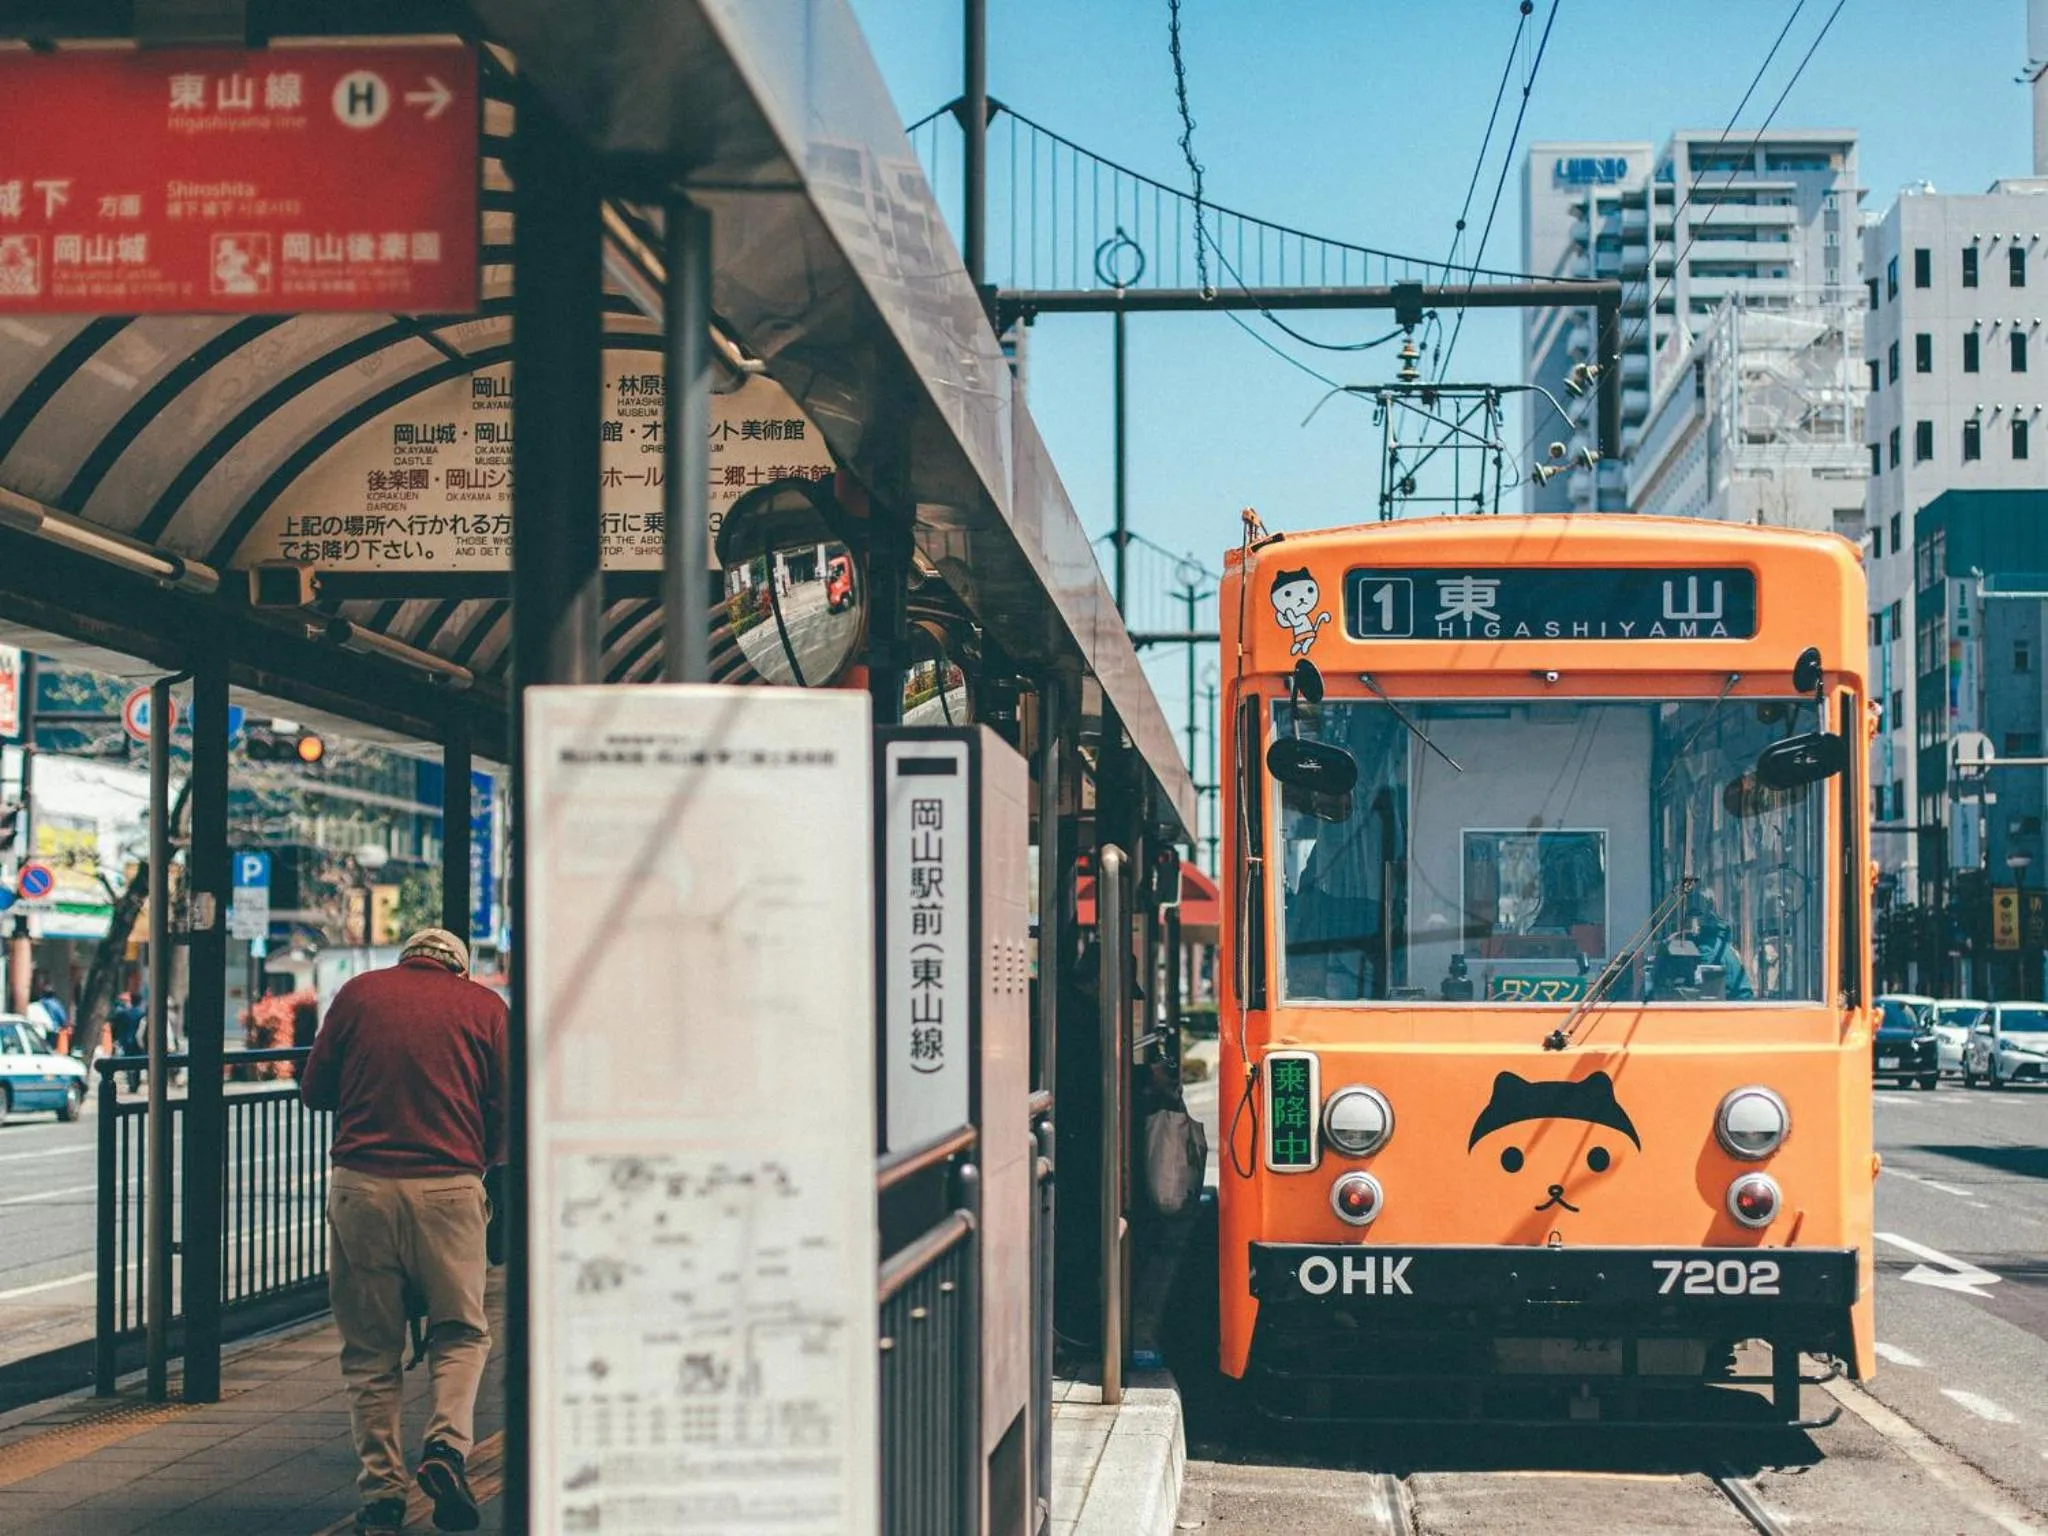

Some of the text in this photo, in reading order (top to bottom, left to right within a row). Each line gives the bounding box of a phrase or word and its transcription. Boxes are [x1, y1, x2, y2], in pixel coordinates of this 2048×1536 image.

[169, 73, 303, 111] 東山線
[349, 81, 374, 115] H
[167, 181, 256, 197] Shiroshita
[99, 194, 142, 217] 方面
[54, 234, 147, 263] 岡山城
[617, 408, 659, 417] MUSEUM
[394, 446, 438, 455] OKAYAMA
[394, 457, 433, 466] CASTLE
[366, 492, 419, 501] KORAKUEN
[446, 492, 492, 501] OKAYAMA
[366, 502, 407, 512] GARDEN
[279, 514, 513, 538] 上記の場所へ行かれる方
[455, 536, 491, 546] THOSE
[616, 535, 635, 544] THE
[455, 547, 478, 557] AND
[480, 547, 499, 557] GET
[1374, 577, 1393, 632] 1
[1437, 621, 1728, 638] HIGASHIYAMA
[243, 856, 262, 884] P
[1503, 980, 1579, 1001] ワンマン
[1275, 1060, 1307, 1163] 乗降中
[1299, 1256, 1413, 1295] OHK
[1652, 1260, 1780, 1295] 7202
